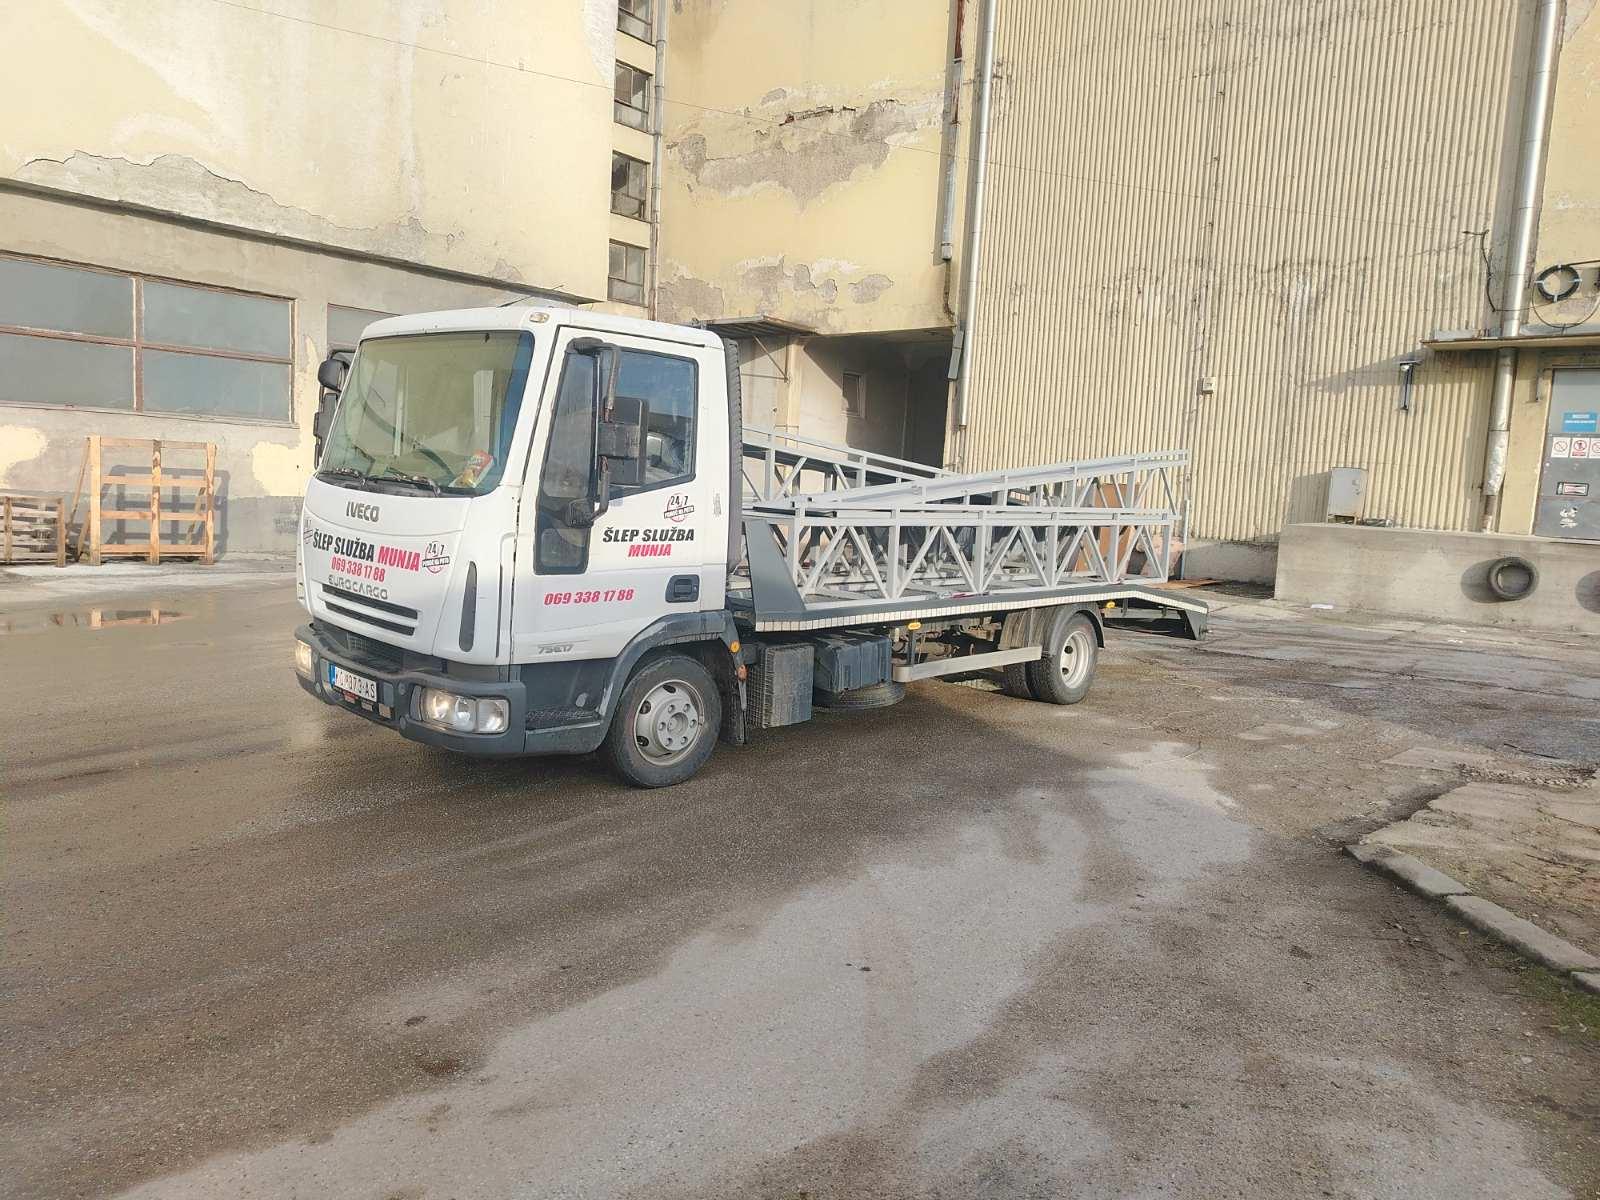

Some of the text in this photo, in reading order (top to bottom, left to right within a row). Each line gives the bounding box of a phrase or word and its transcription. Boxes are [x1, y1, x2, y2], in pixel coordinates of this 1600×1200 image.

[346, 501, 380, 522] IVECO
[602, 526, 695, 543] ŠLEP SLUŽBA
[313, 528, 334, 552] ŠLEP
[334, 536, 375, 562] SLUŽBA
[377, 545, 421, 572] MUNJA
[627, 543, 672, 558] MUNJA
[331, 555, 386, 583] 069 338 17 88
[543, 588, 635, 606] 069 338 17 88
